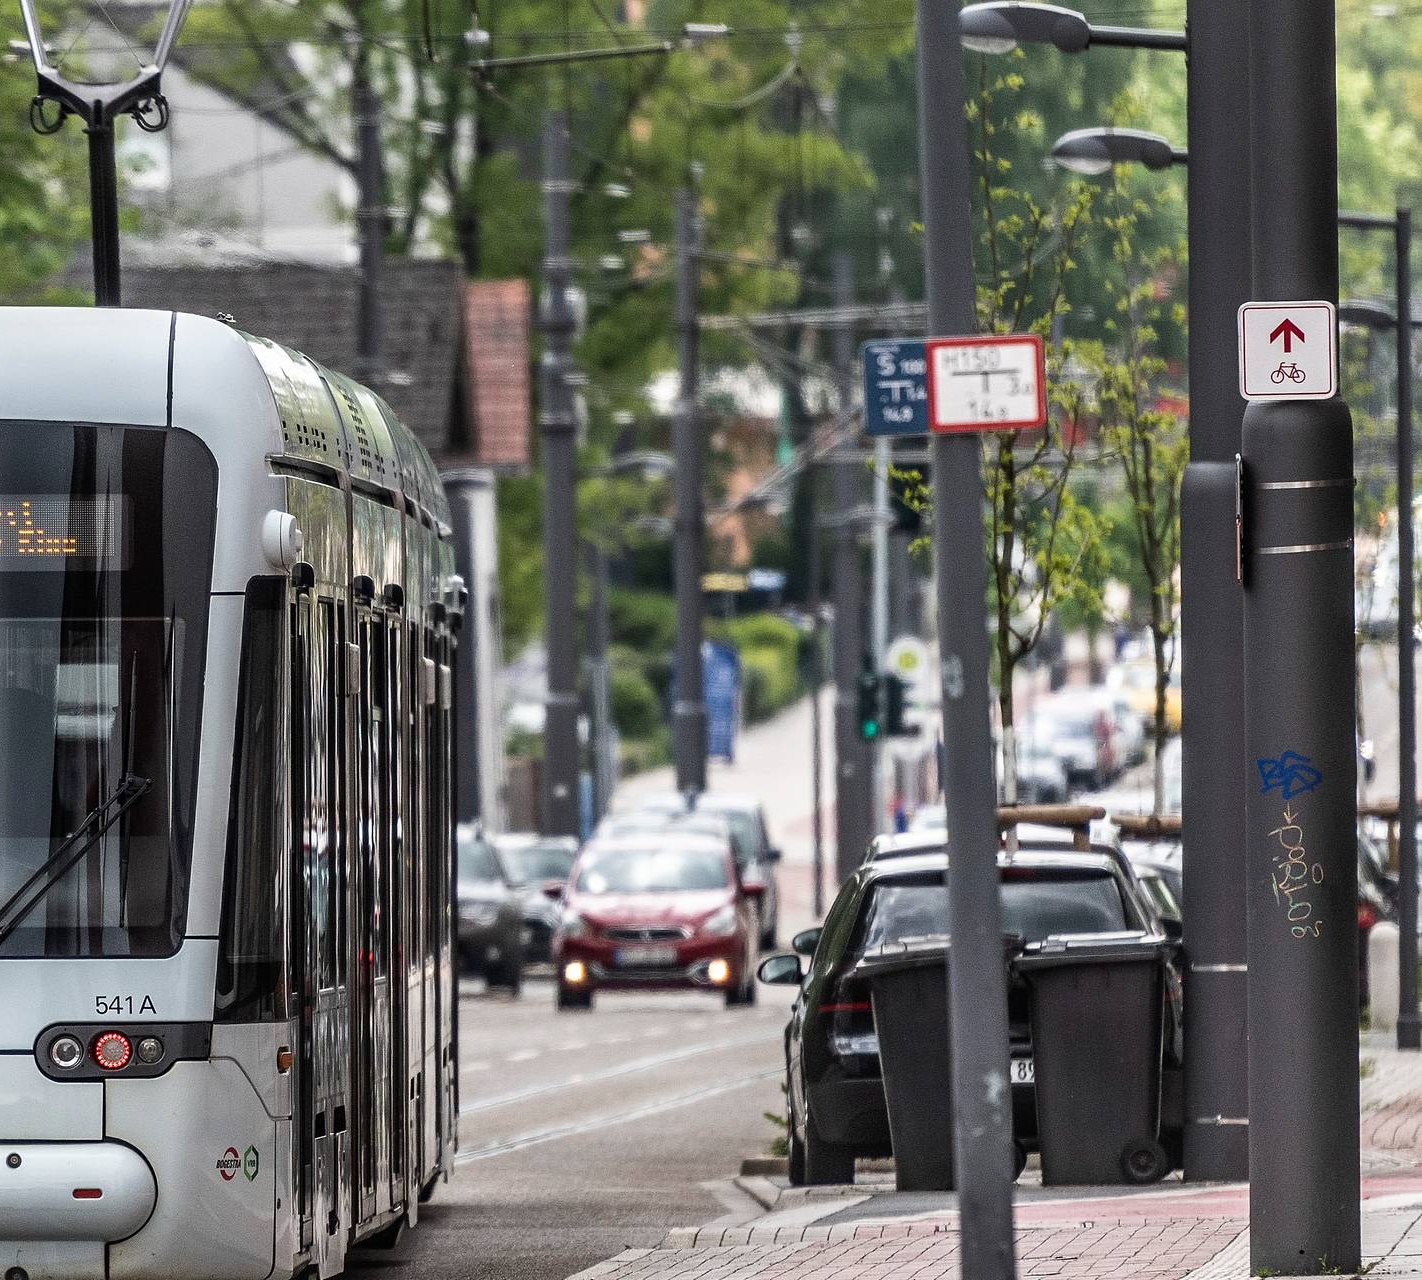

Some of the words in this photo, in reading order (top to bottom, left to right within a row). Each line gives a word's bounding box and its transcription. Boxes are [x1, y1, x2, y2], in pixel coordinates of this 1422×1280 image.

[95, 995, 133, 1015] 541
[139, 994, 157, 1015] A
[215, 1159, 242, 1169] BOGESTRA
